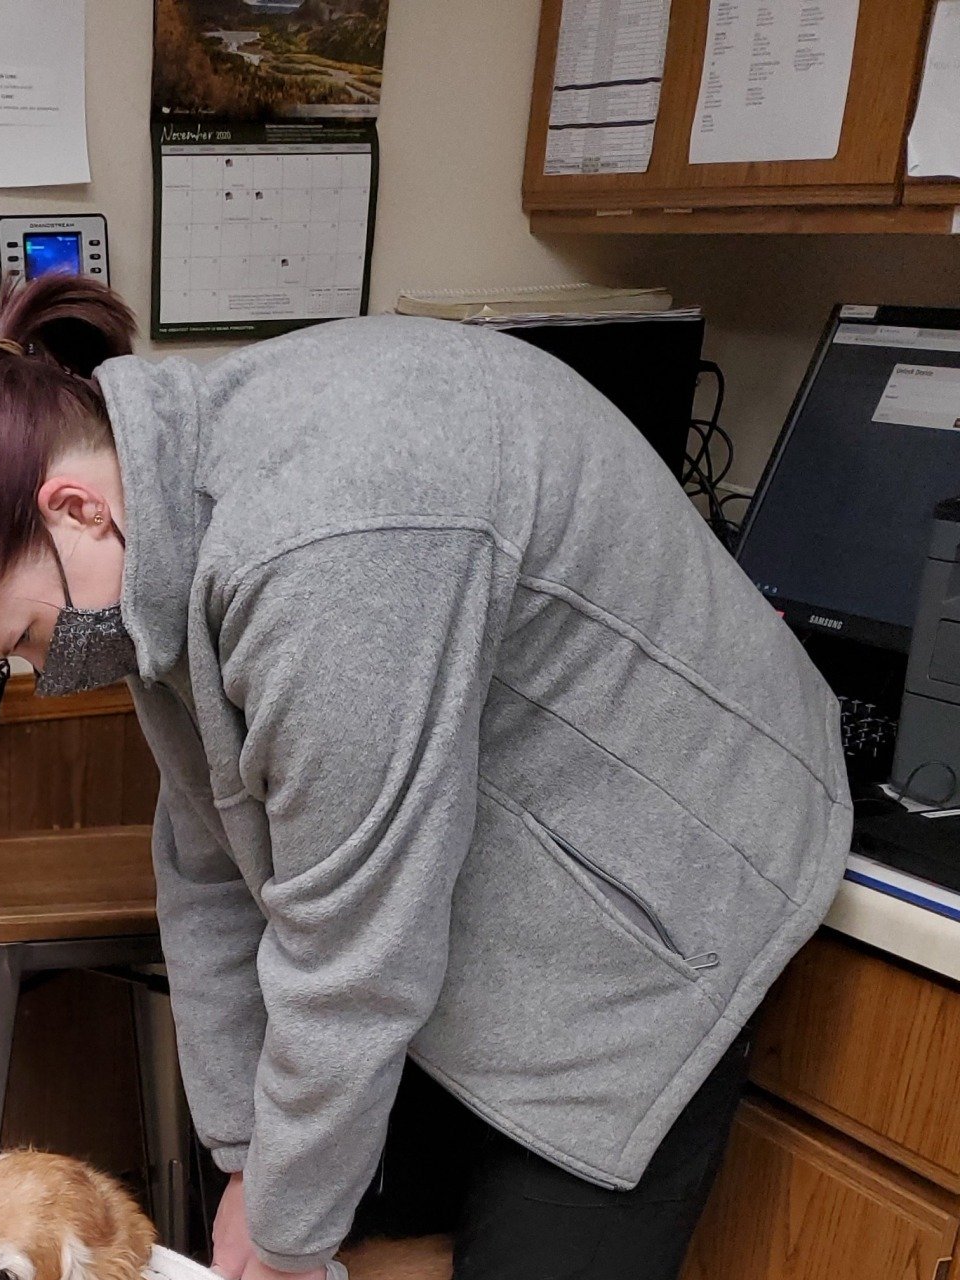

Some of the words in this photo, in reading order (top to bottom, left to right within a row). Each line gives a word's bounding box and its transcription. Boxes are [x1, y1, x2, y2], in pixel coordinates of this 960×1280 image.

[161, 123, 213, 143] November
[216, 131, 231, 141] 2020
[809, 615, 843, 630] SAMSUNG
